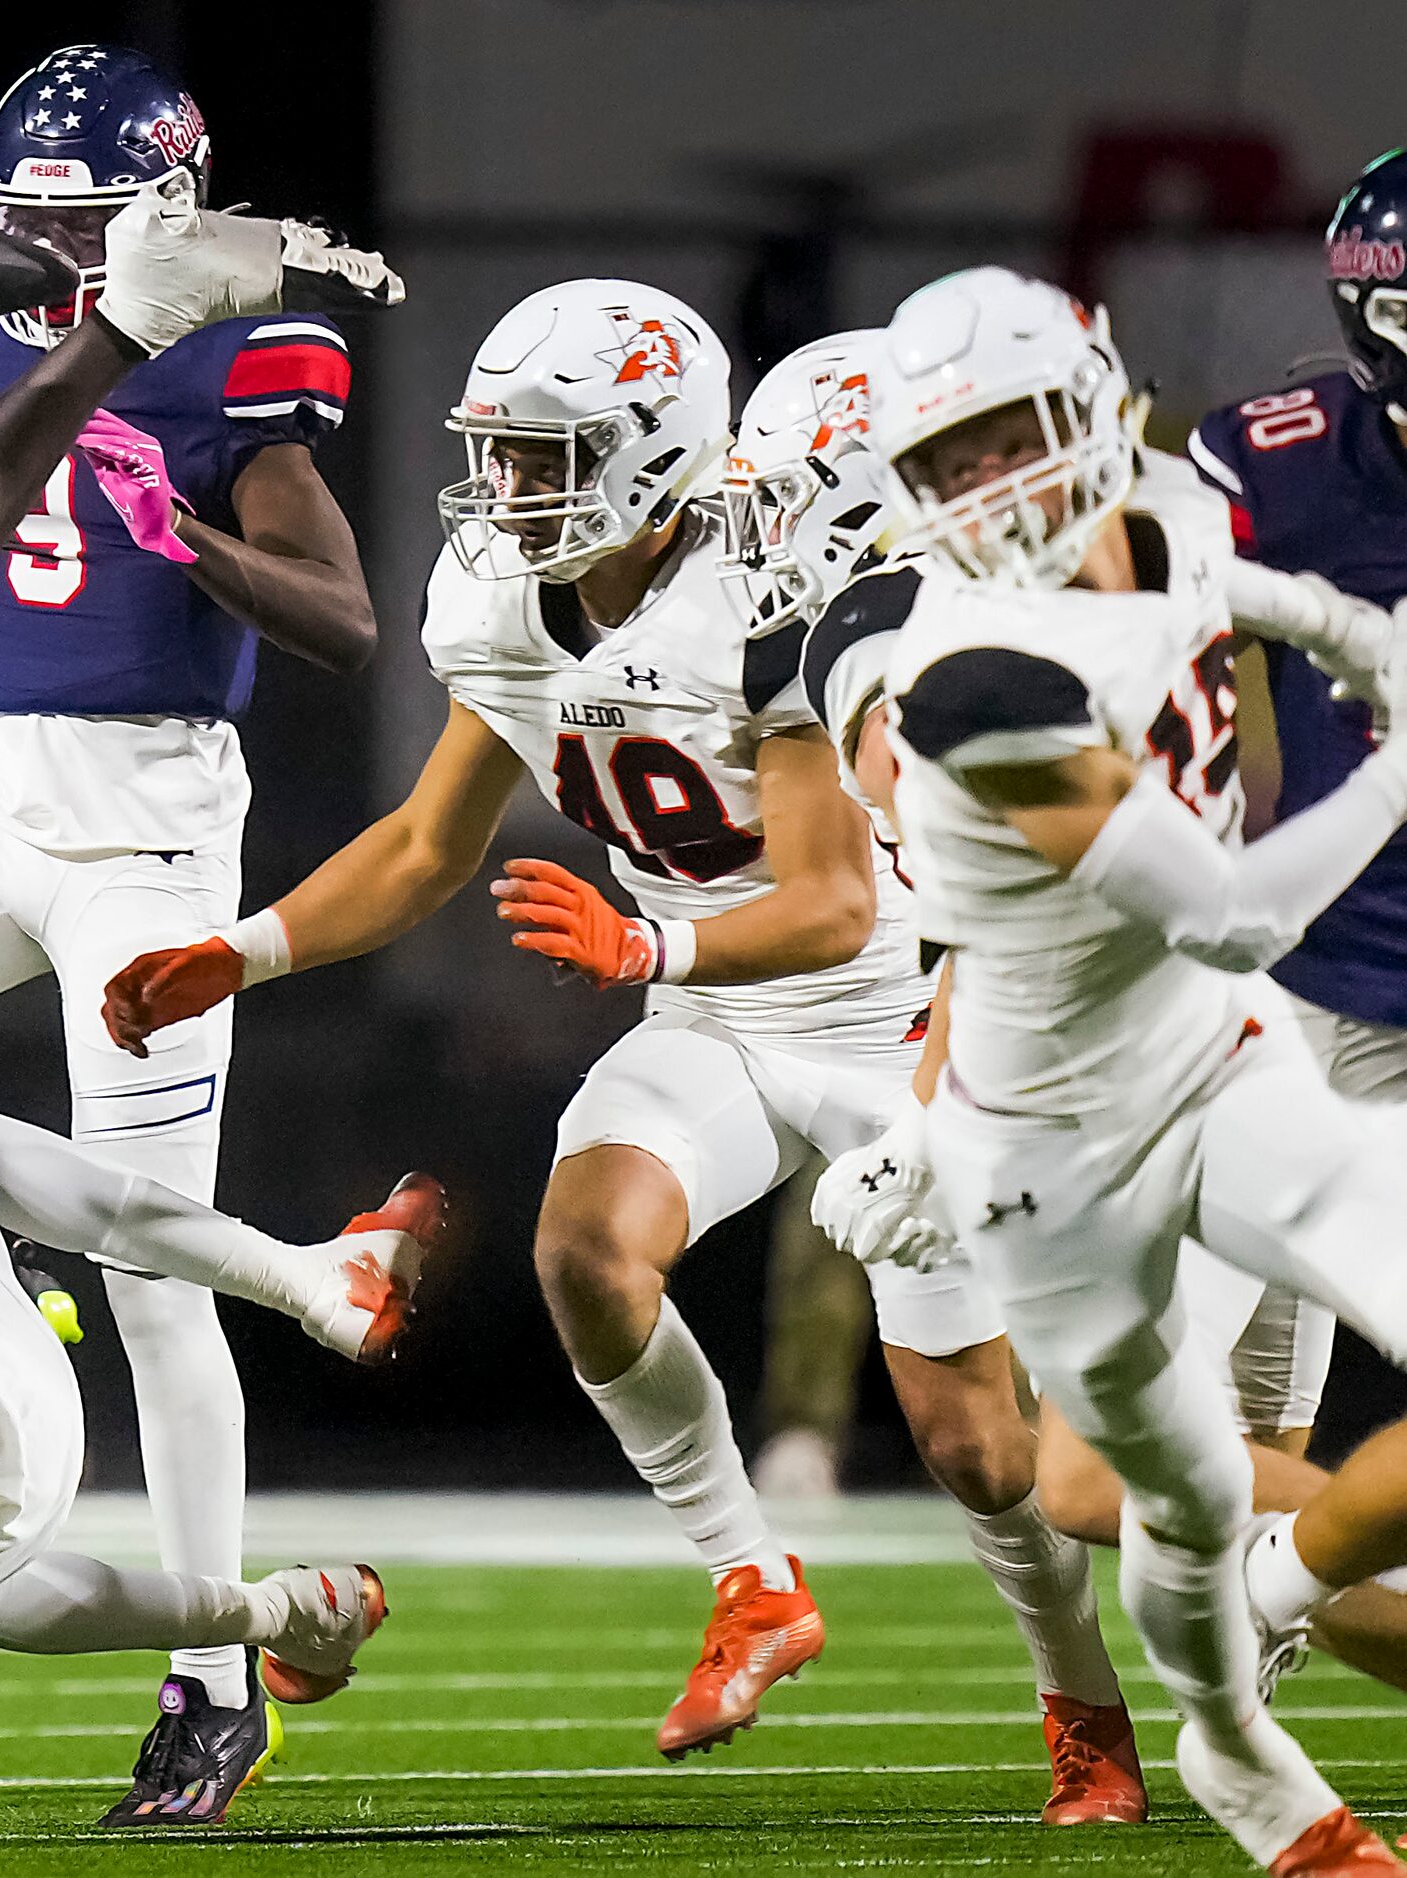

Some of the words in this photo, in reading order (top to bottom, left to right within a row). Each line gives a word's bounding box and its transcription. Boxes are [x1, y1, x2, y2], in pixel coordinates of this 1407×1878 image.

[30, 164, 71, 178] #EDGE
[1239, 388, 1328, 450] 80
[560, 702, 627, 728] ALEDO
